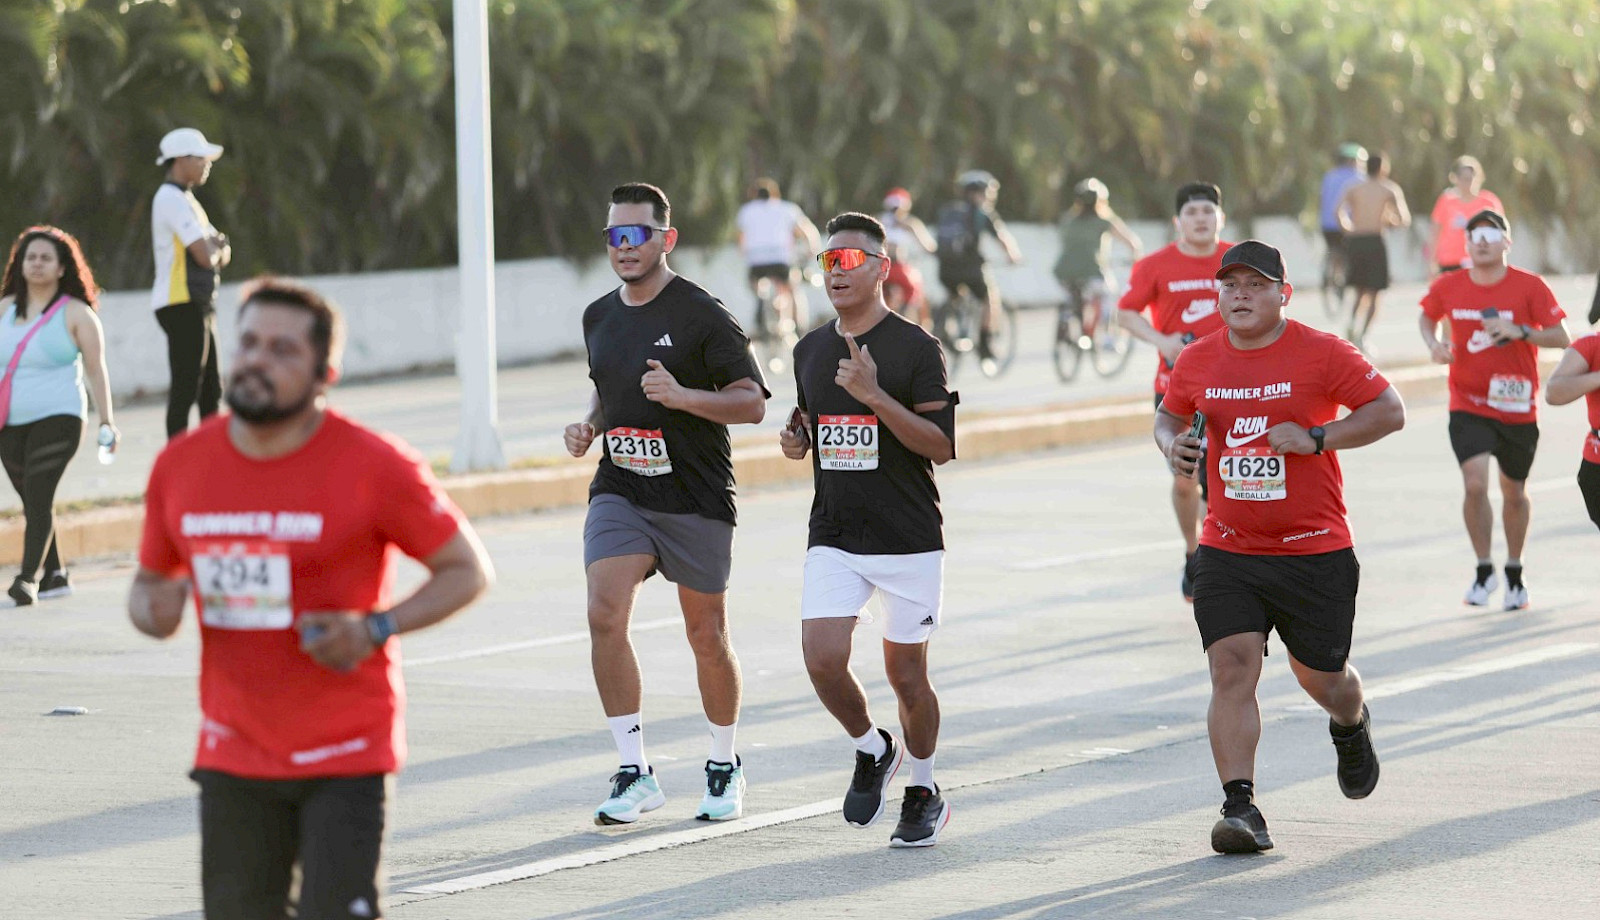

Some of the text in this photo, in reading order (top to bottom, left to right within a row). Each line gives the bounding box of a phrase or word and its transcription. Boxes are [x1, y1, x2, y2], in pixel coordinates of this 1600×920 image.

[1205, 387, 1261, 400] SUMMER
[1264, 382, 1292, 397] RUN
[1232, 416, 1268, 435] RUN
[821, 426, 873, 446] 2350
[611, 436, 662, 457] 2318
[830, 460, 863, 469] MEDALLA
[1224, 457, 1280, 477] 1629
[181, 512, 323, 537] SUMMER RUN
[209, 556, 269, 591] 294
